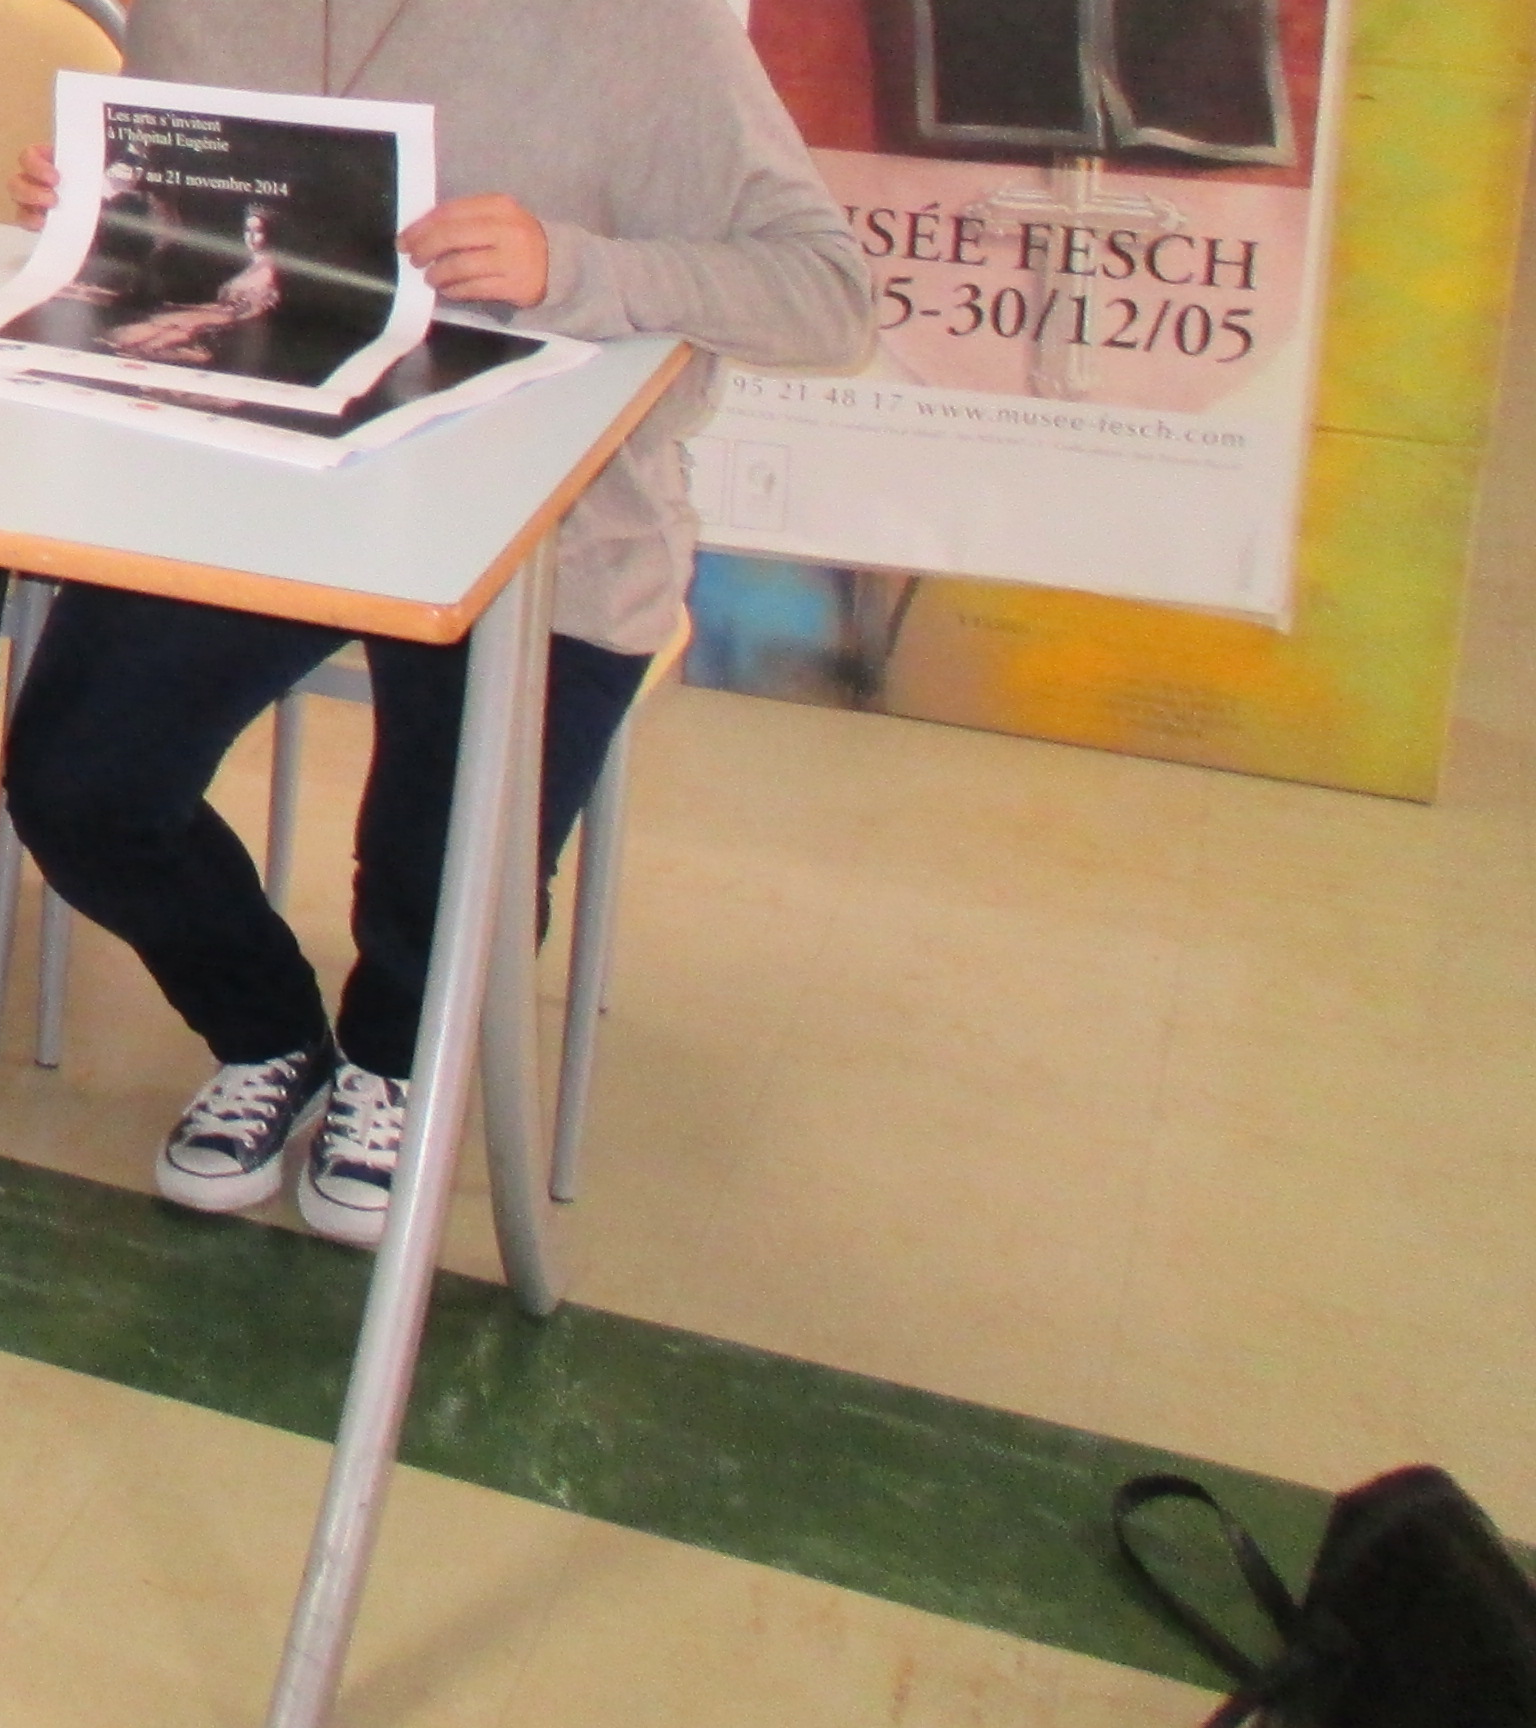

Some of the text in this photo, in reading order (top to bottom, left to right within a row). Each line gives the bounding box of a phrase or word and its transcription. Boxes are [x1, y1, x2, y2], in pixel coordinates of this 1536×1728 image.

[107, 107, 222, 133] Les arts s'invitent
[176, 134, 230, 153] Eugénie
[146, 171, 162, 183] au
[165, 170, 181, 184] 21
[185, 174, 252, 194] novembre
[254, 178, 289, 197] 2014
[843, 202, 1259, 291] SÉE FESCH
[871, 275, 1255, 364] 5-30/12/05
[733, 375, 763, 395] 95
[779, 381, 808, 402] 21
[825, 386, 856, 407] 48
